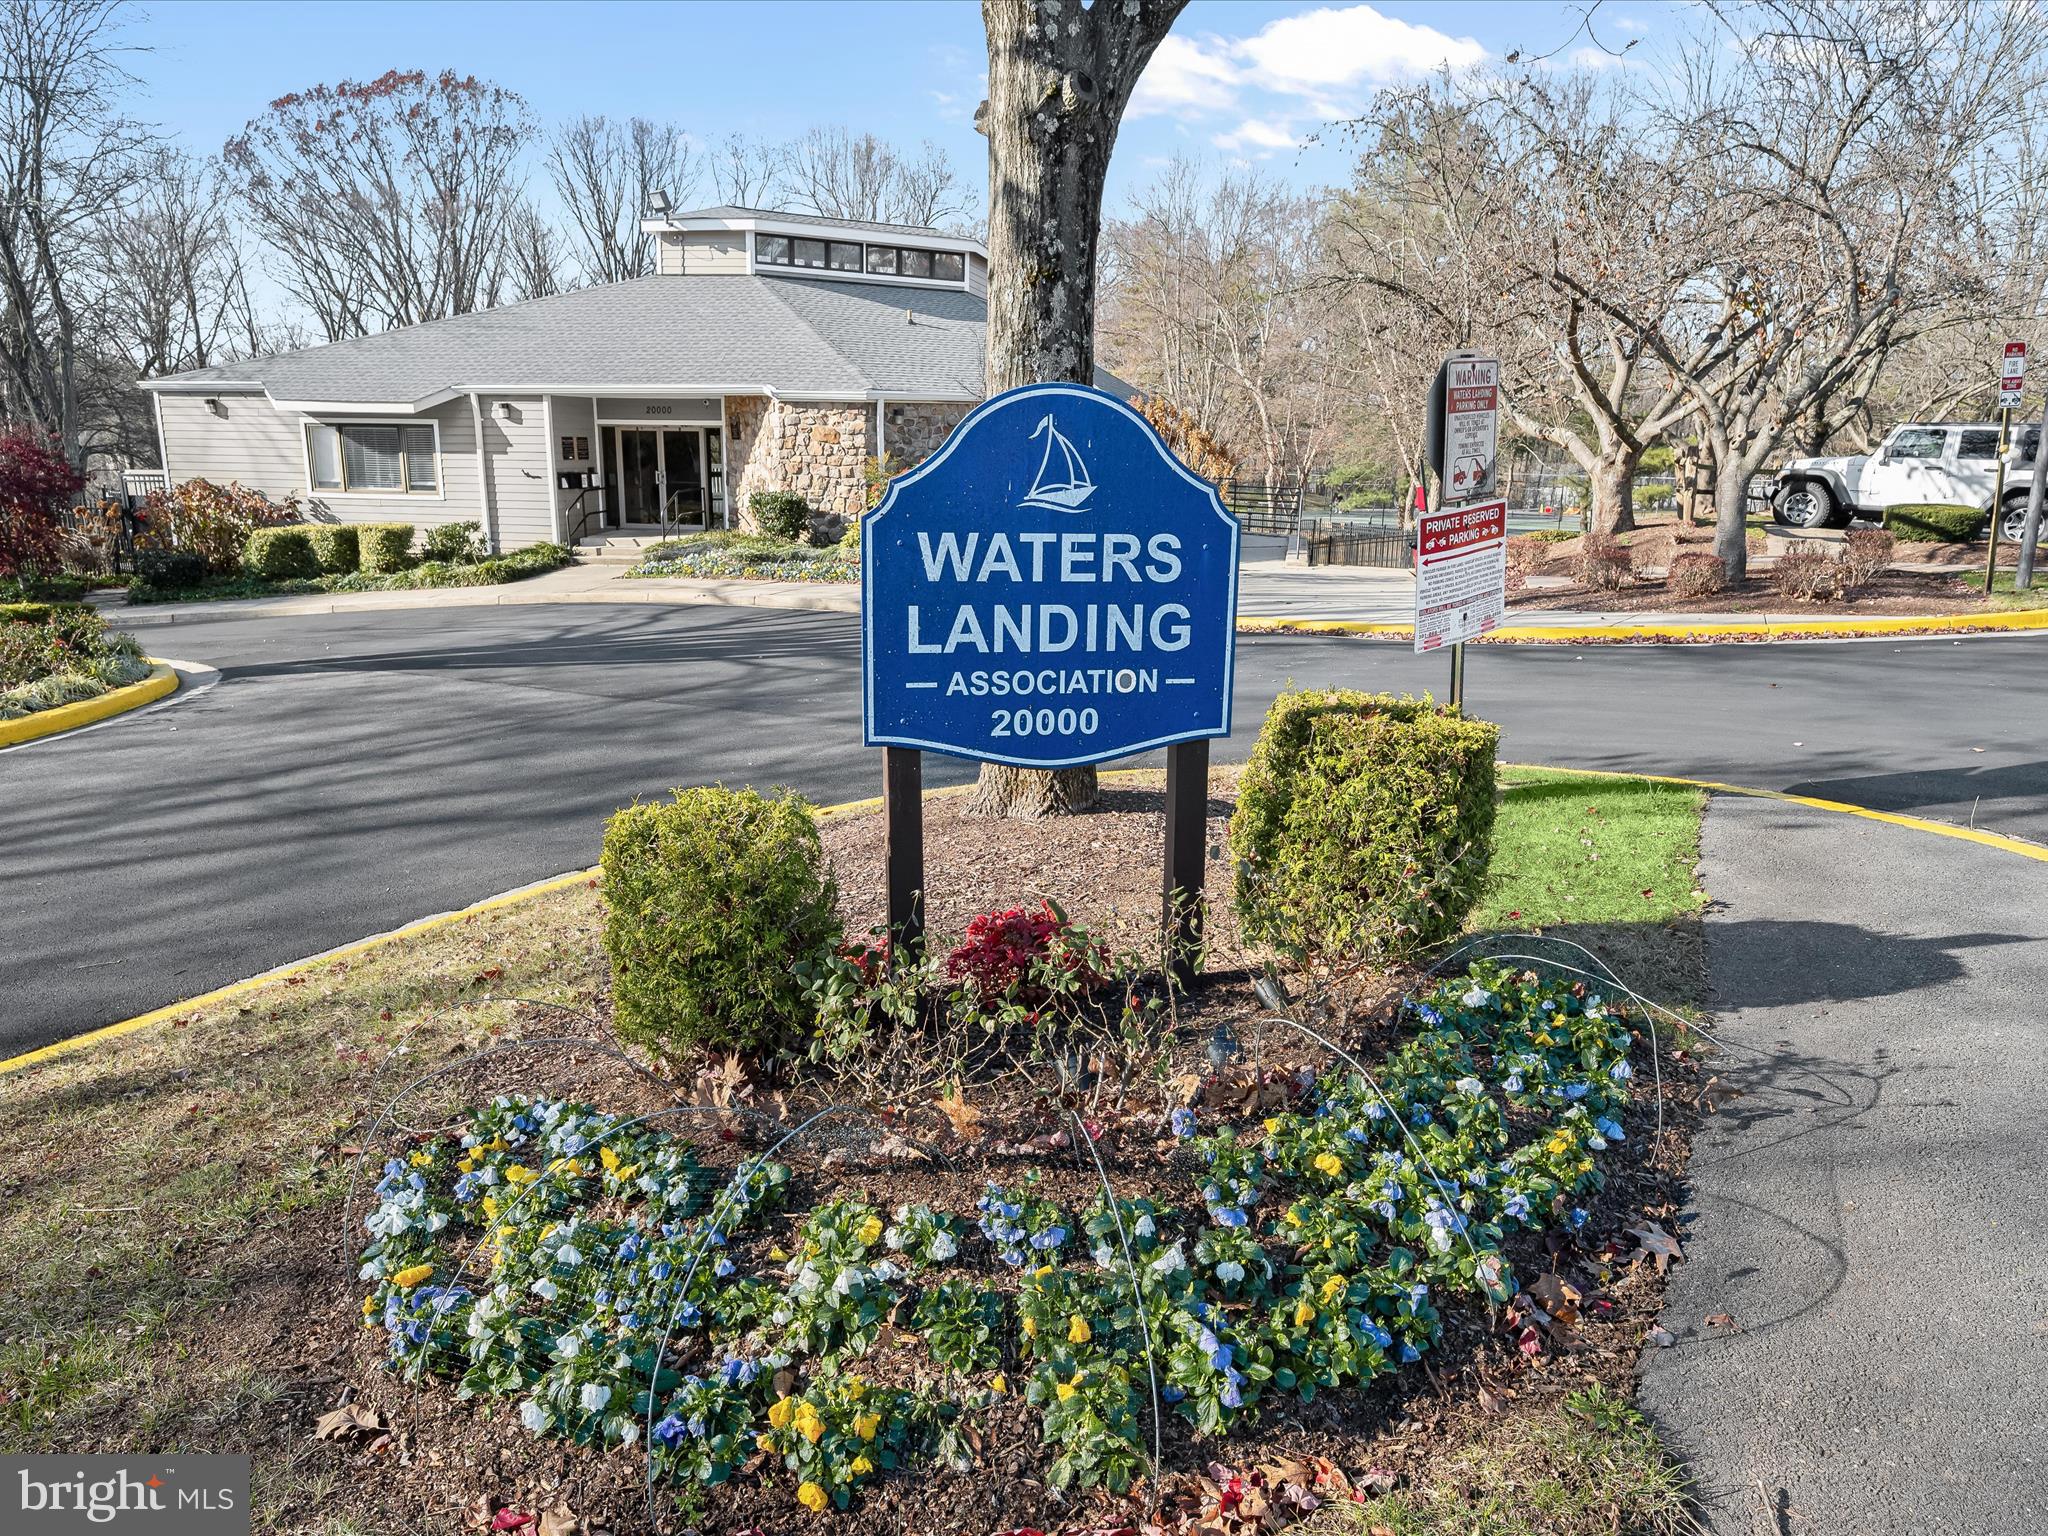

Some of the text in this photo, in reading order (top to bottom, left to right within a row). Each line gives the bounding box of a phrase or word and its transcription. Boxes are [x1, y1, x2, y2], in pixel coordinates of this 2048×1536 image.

[1456, 369, 1491, 386] WARNING
[646, 406, 672, 414] 20000
[1456, 400, 1488, 411] PARKING ONLY
[1426, 508, 1500, 534] PRIVATE RESERVED
[1449, 528, 1479, 546] PARKING
[917, 532, 1182, 583] WATERS
[908, 603, 1191, 654] LANDING
[946, 668, 1158, 696] ASSOCIATION
[990, 708, 1099, 737] 20000
